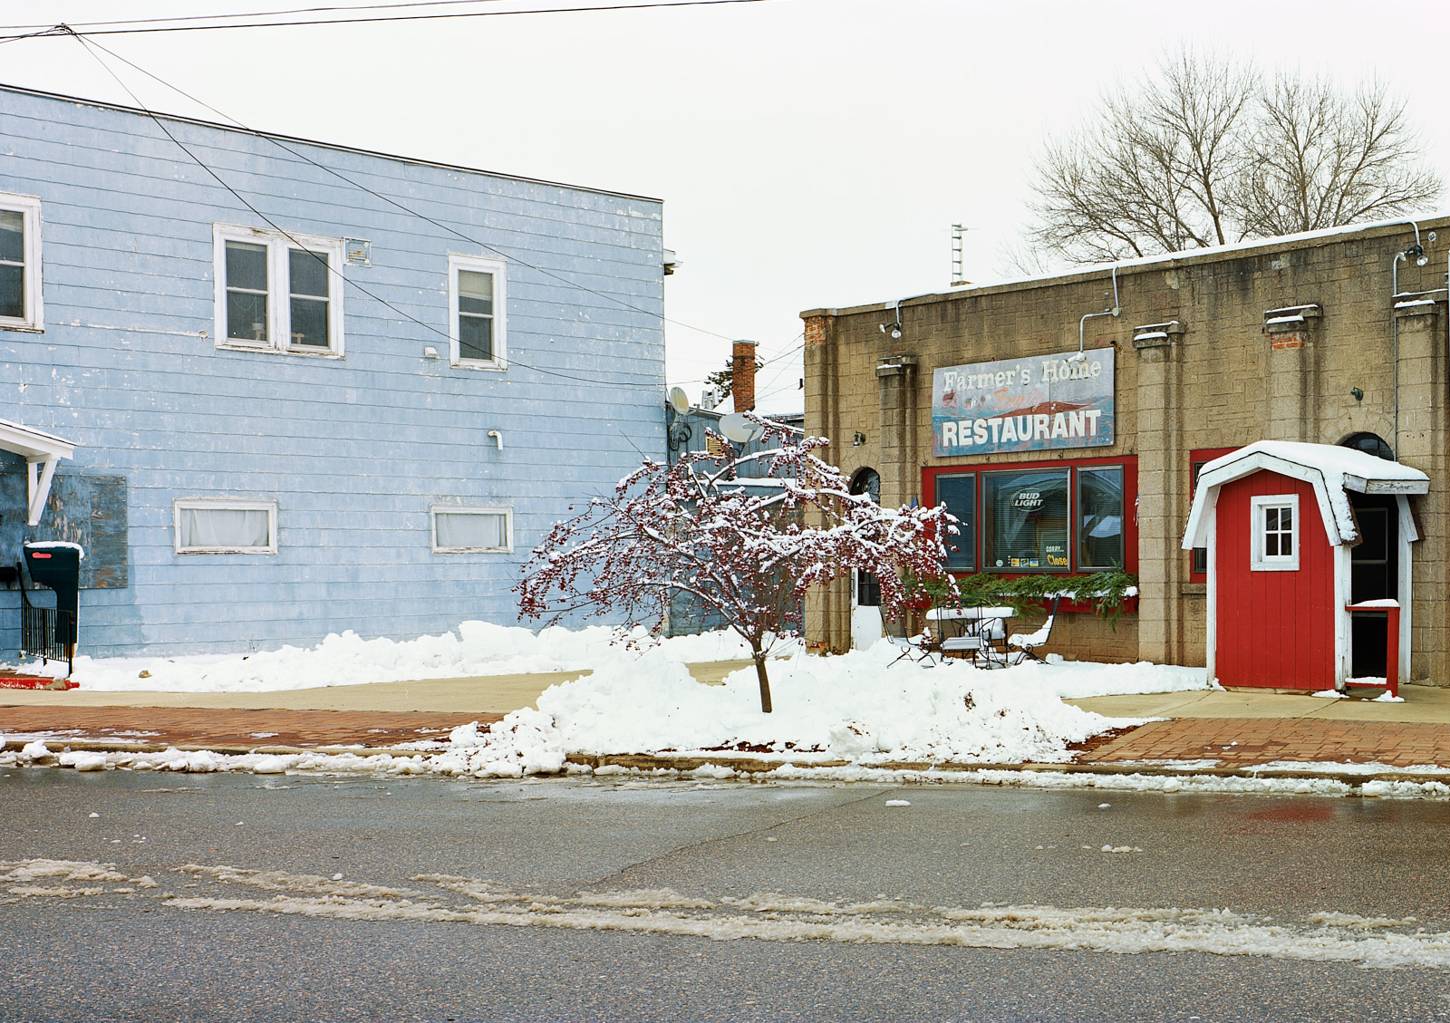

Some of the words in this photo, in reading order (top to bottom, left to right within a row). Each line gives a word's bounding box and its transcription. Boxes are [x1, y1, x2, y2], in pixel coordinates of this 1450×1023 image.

[943, 365, 1031, 392] Farmer's
[1040, 359, 1101, 382] Home
[942, 409, 1101, 447] RESTAURANT
[1019, 492, 1040, 500] BUD
[1014, 499, 1044, 507] LIGHT
[1047, 554, 1068, 566] Close
